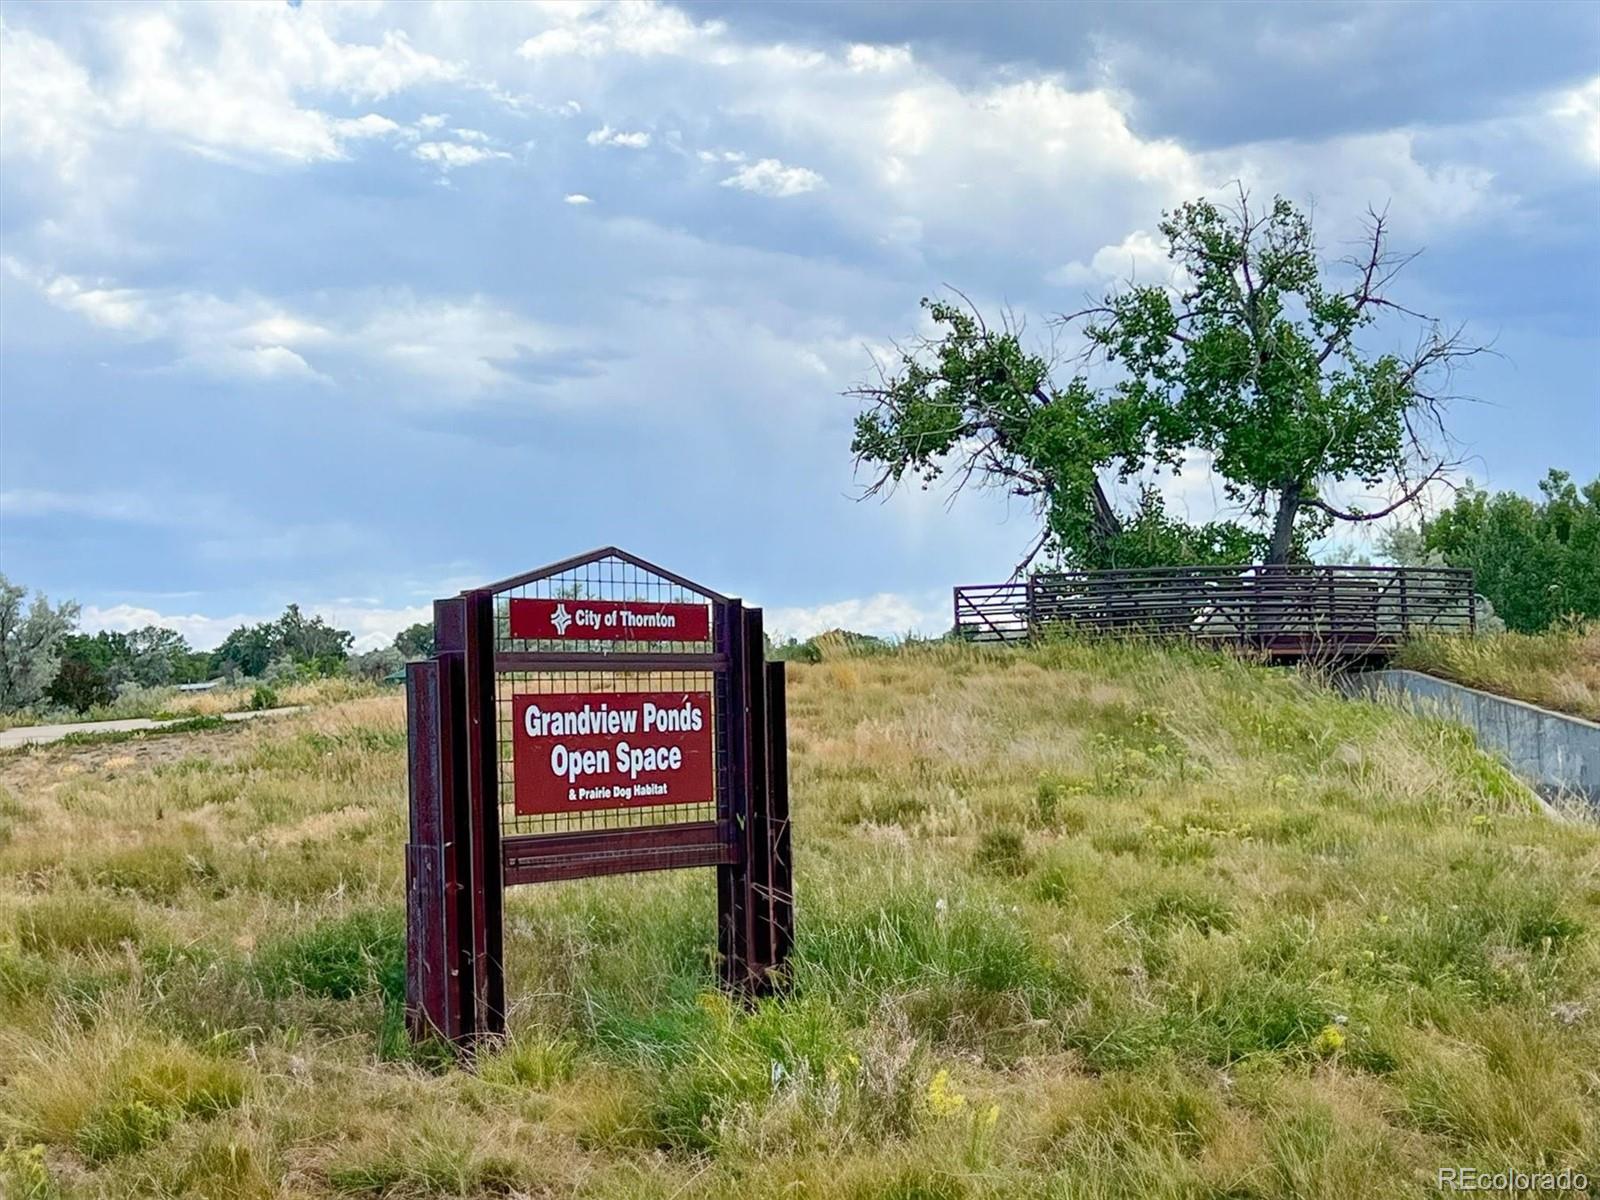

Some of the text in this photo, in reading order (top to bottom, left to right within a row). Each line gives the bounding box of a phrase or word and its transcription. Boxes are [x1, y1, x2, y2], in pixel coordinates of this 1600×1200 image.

[575, 609, 676, 630] City of Thornton
[525, 702, 703, 737] Grandview Ponds
[551, 741, 682, 784] Open Space
[568, 783, 668, 801] & Prairie Dog Habitat
